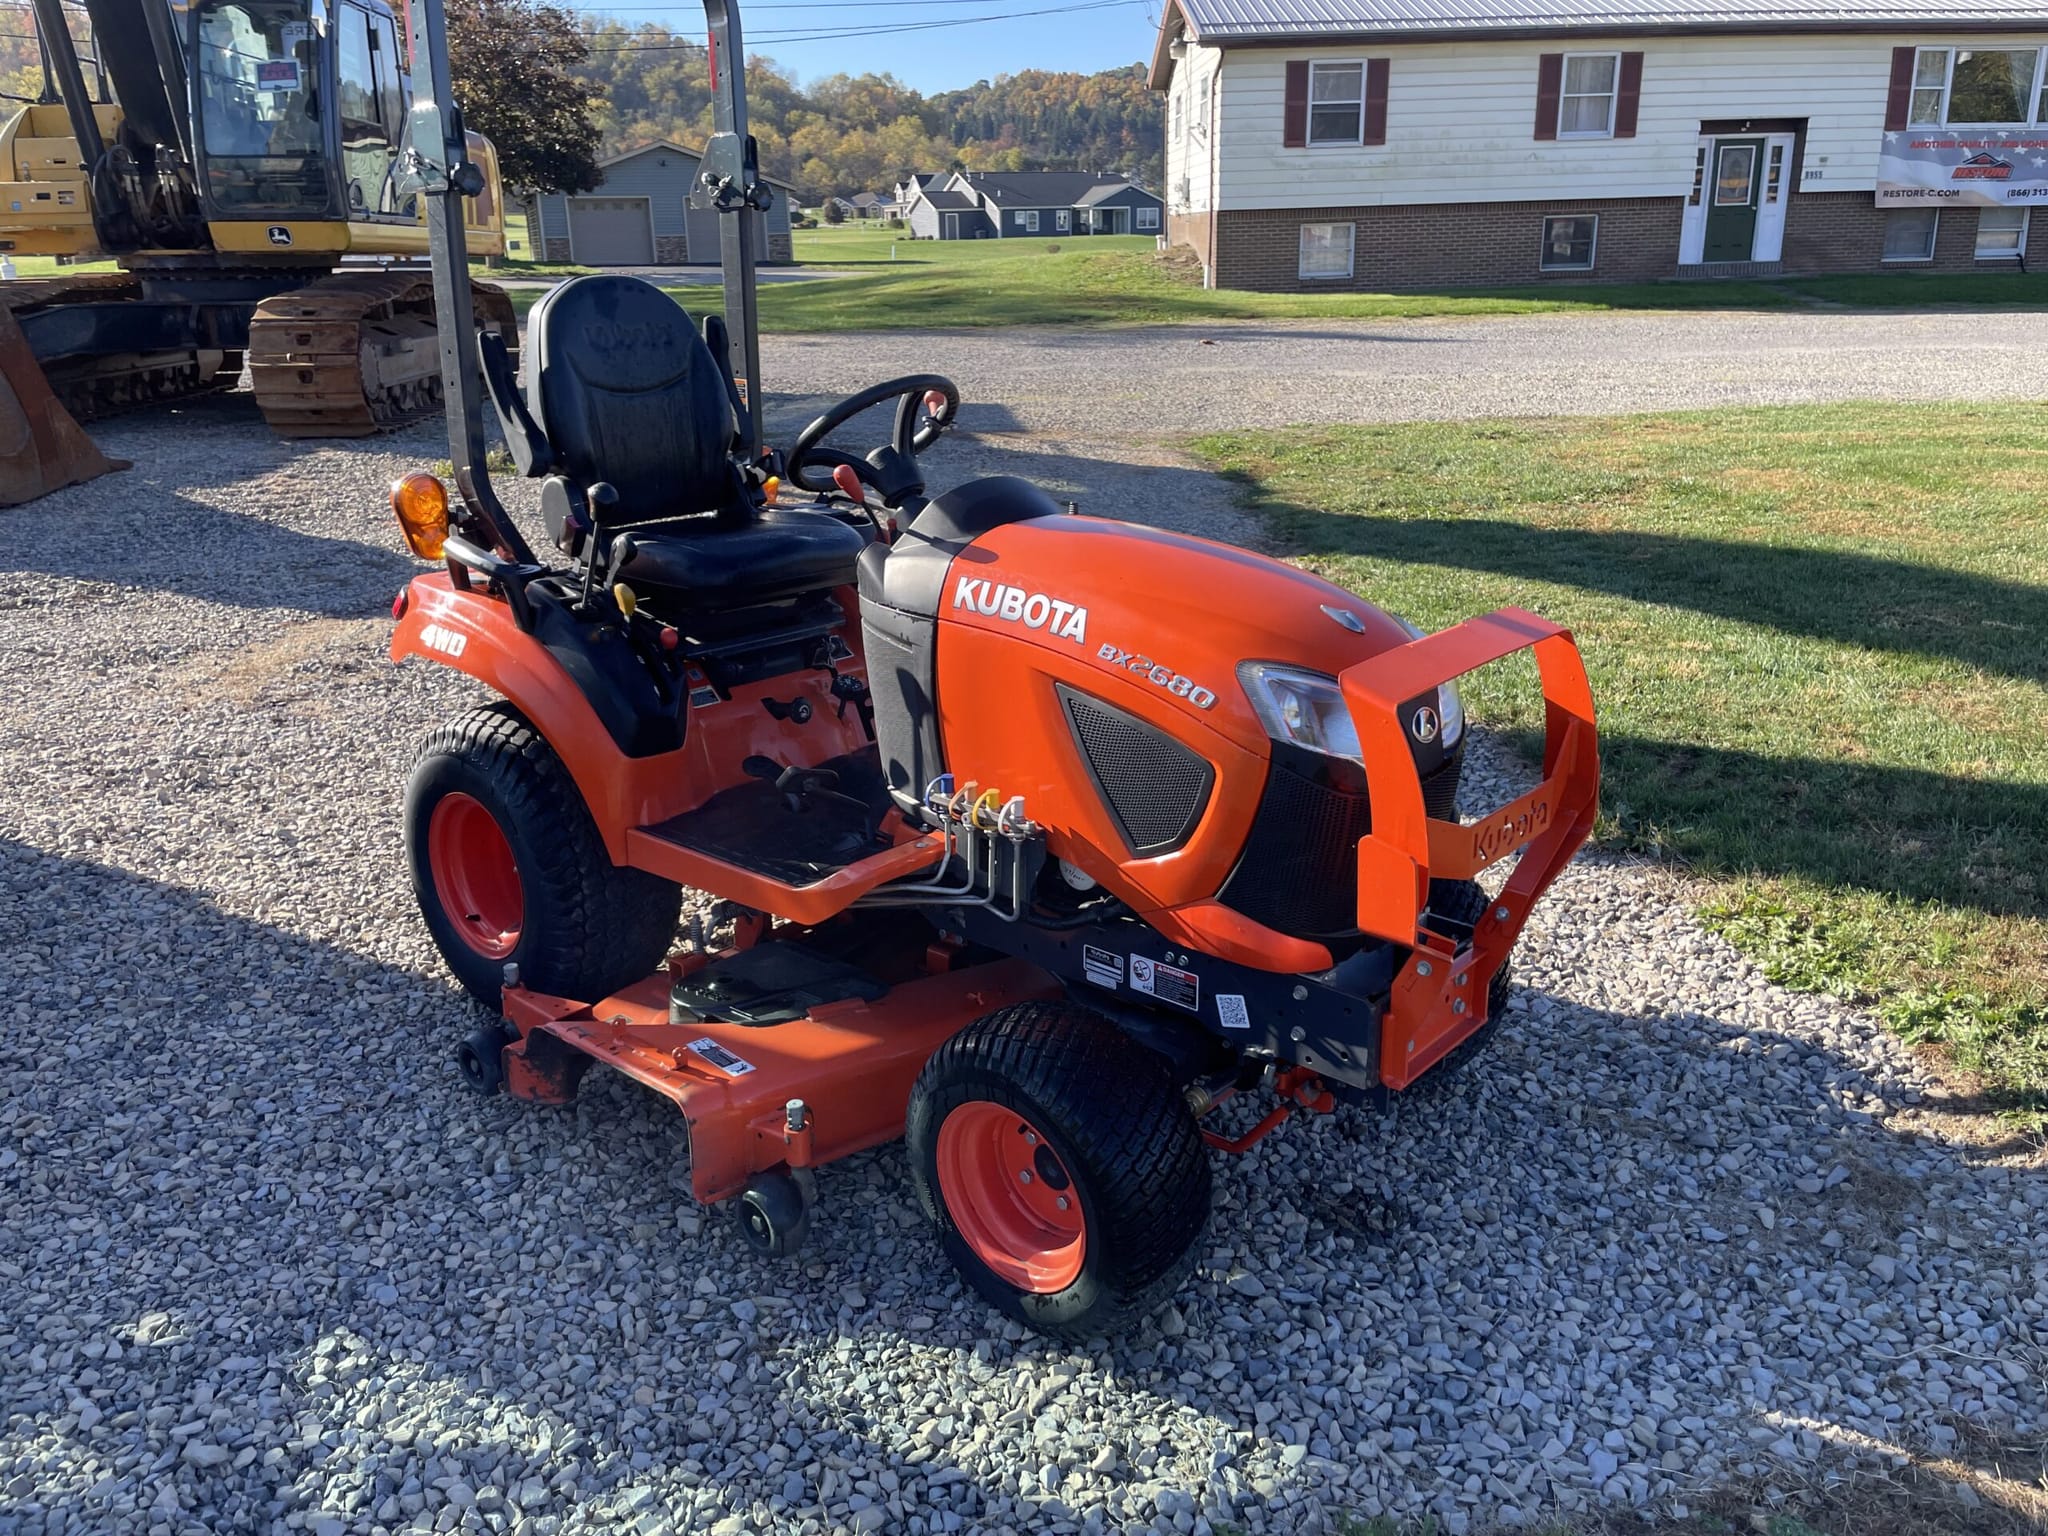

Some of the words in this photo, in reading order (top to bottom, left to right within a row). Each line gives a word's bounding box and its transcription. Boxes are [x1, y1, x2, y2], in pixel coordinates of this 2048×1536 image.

[1883, 189, 1960, 198] RESTORE-C.COM
[2007, 189, 2031, 198] (866)
[420, 623, 467, 657] 4WD
[953, 576, 1088, 645] KUBOTA
[1097, 643, 1217, 709] BX2680
[1473, 799, 1548, 861] Kubota
